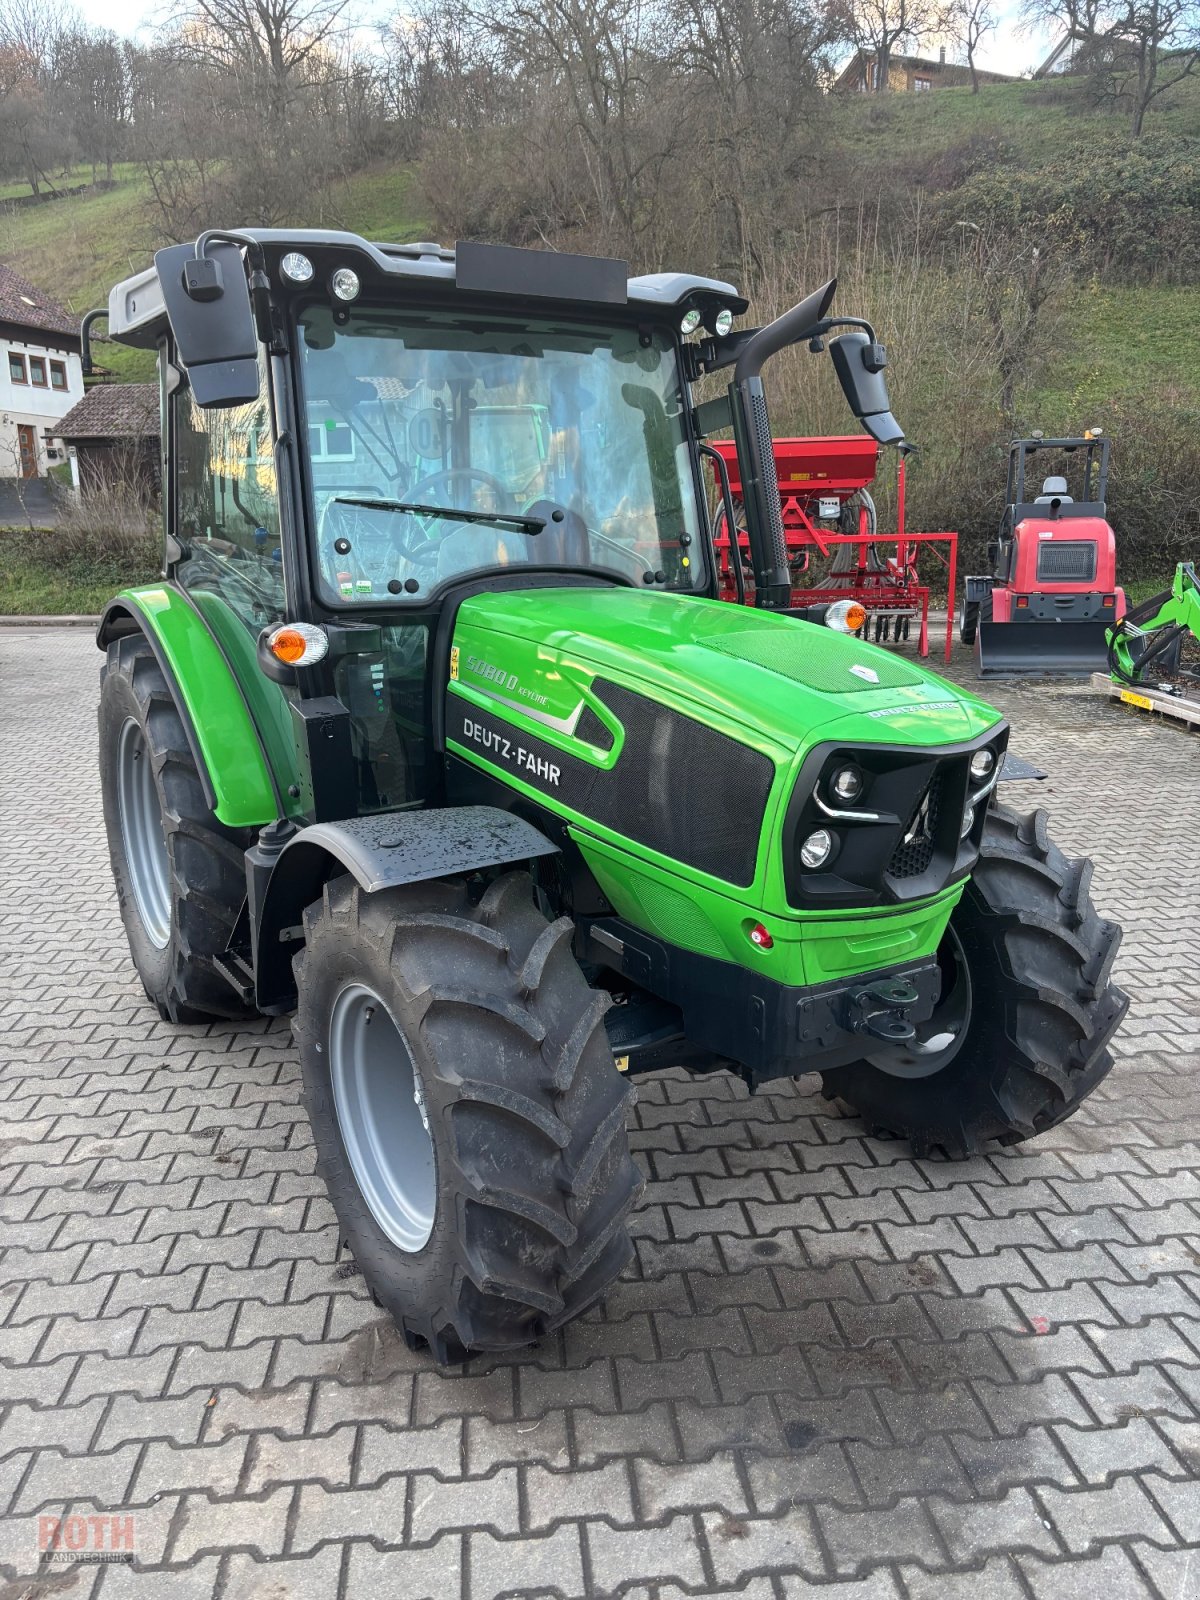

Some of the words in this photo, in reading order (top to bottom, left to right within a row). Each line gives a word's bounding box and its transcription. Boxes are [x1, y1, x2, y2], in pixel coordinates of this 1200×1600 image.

[465, 656, 507, 686] 5080
[518, 687, 548, 705] KEYLINE
[464, 718, 561, 786] DEUTZ-FAHR
